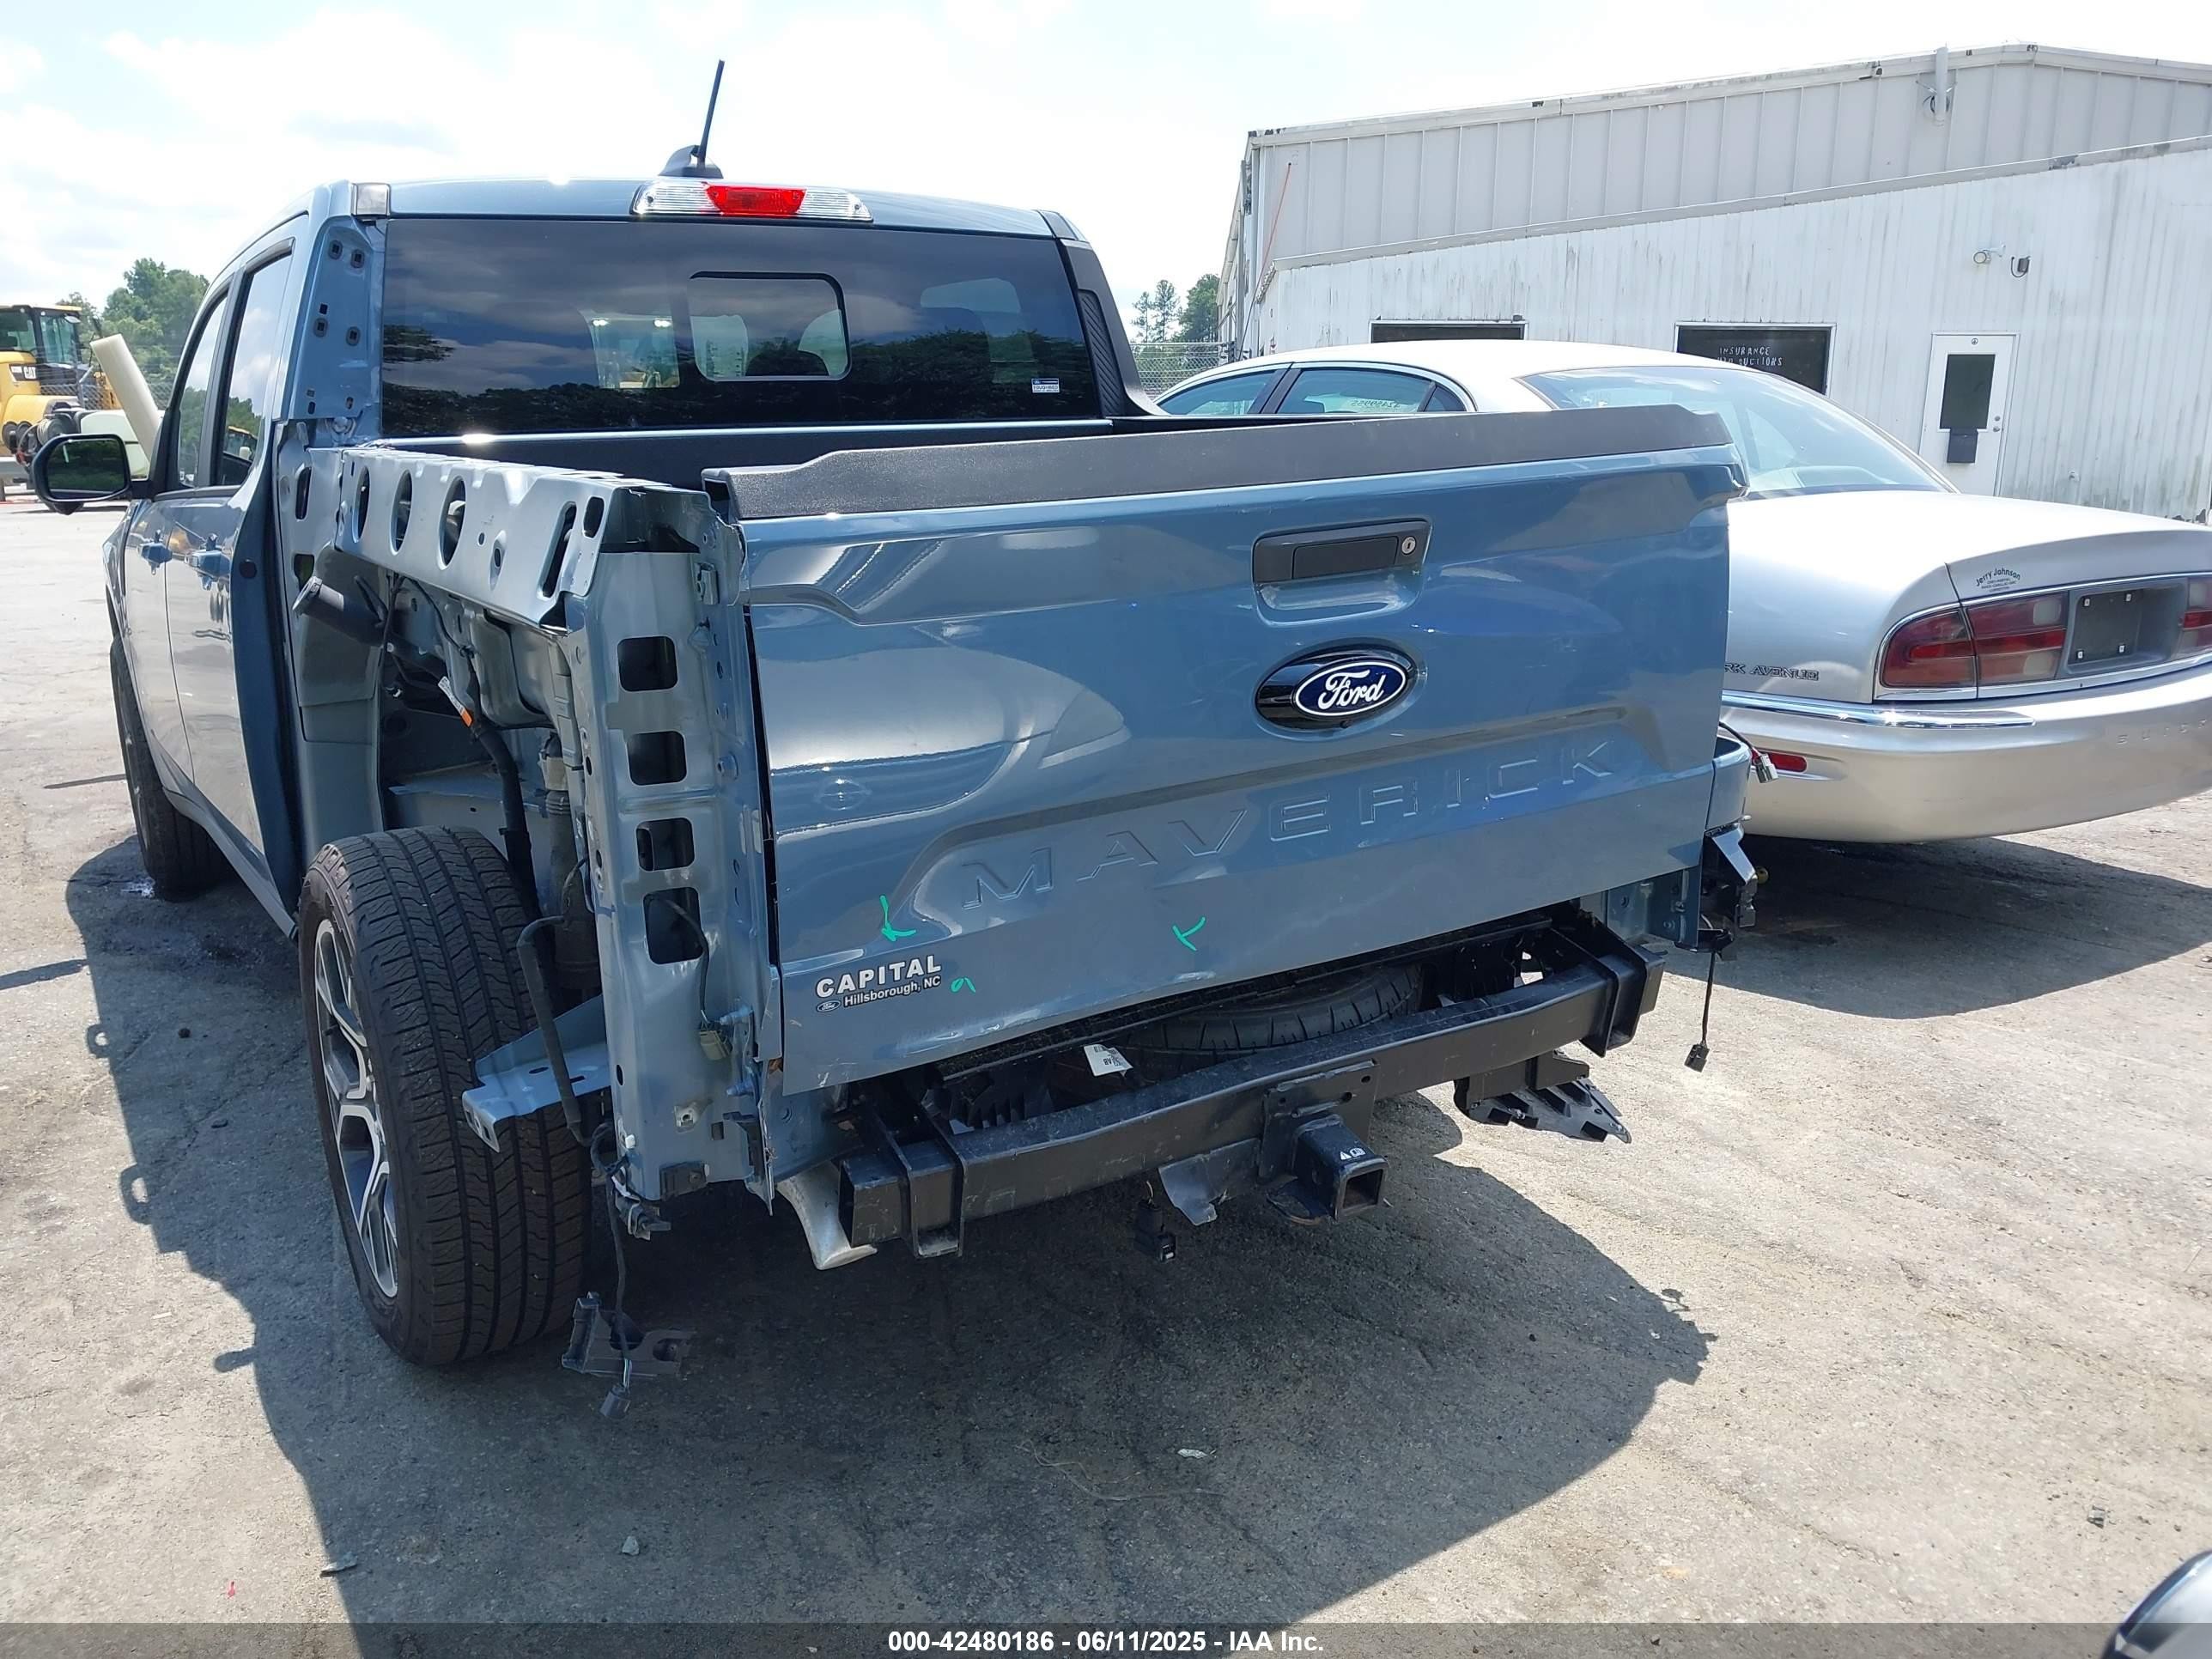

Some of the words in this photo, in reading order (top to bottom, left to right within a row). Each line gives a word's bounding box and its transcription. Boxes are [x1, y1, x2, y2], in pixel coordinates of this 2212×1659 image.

[1719, 346, 1771, 356] INSURANCE
[1976, 570, 1992, 586] Jerry
[1993, 567, 2021, 580] Johnson
[1750, 665, 1820, 681] AVENUE
[1317, 669, 1386, 710] Ford
[962, 739, 1614, 911] MAVERICK
[817, 956, 941, 998] CAPITAL
[844, 982, 922, 1007] Hillsborough,
[923, 975, 941, 988] NC
